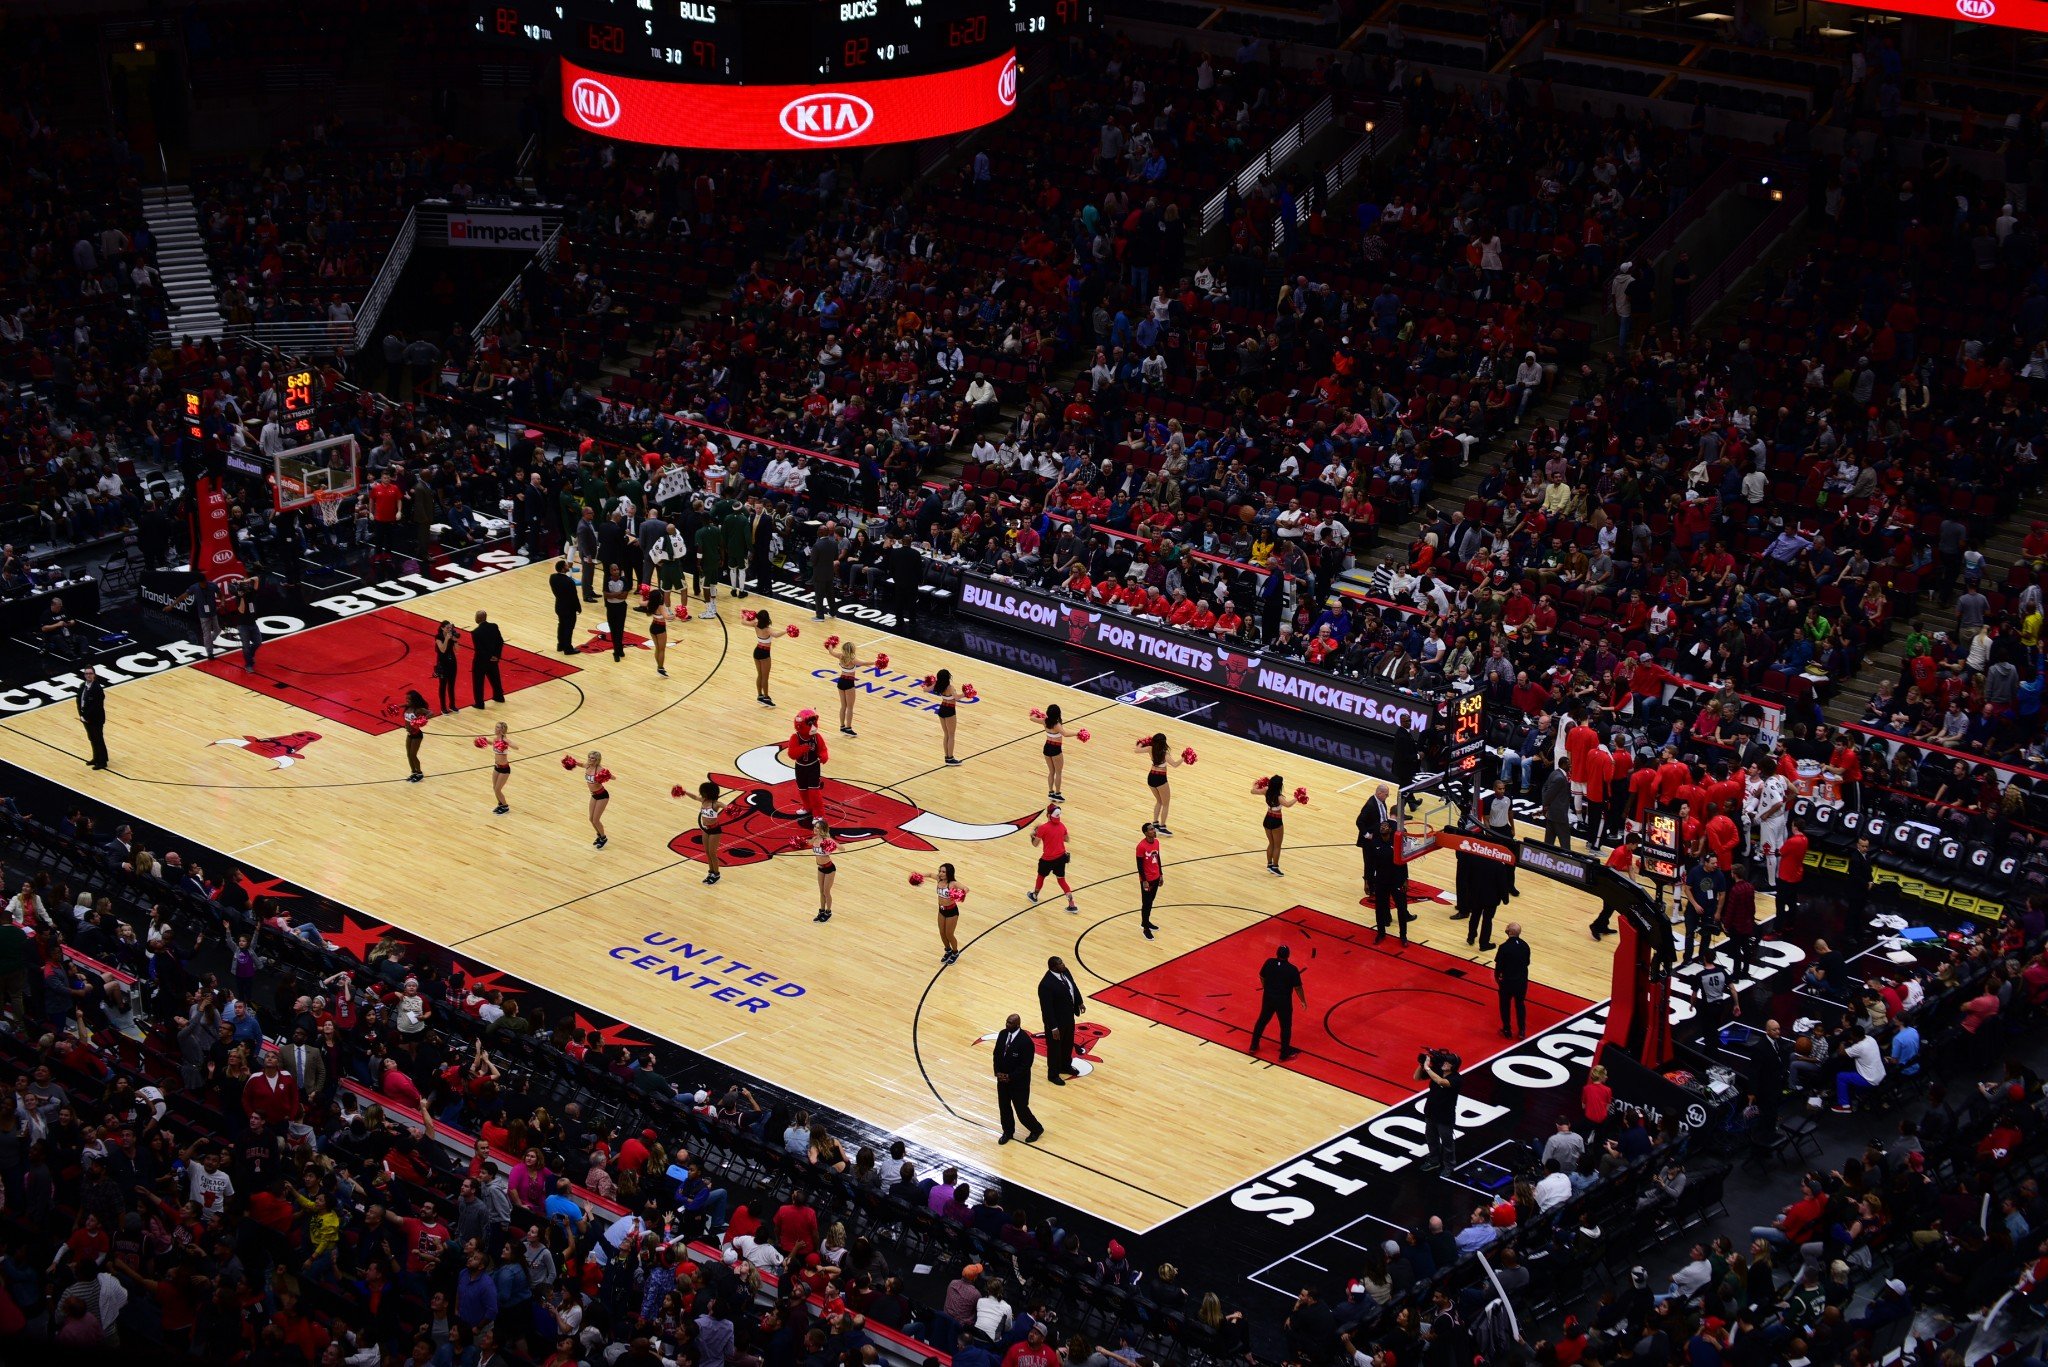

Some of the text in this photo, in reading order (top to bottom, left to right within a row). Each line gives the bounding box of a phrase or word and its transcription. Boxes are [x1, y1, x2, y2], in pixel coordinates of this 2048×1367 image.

[680, 1, 716, 23] BULLS
[840, 1, 878, 21] BUCKS
[1963, 0, 1990, 14] KIA
[496, 7, 517, 36] 82
[1015, 22, 1027, 32] TOL
[588, 25, 625, 54] 6:20
[949, 16, 988, 47] 6:20
[651, 46, 662, 59] TOL
[692, 41, 717, 69] 97
[845, 38, 869, 68] 82
[898, 44, 910, 55] TOL
[577, 87, 612, 120] KIA
[795, 103, 859, 132] KIA
[466, 217, 540, 243] impact
[287, 372, 310, 388] 6:20
[286, 387, 309, 410] 24
[291, 408, 315, 417] TISSOT
[226, 455, 262, 475] Bulls.com
[209, 494, 222, 504] ZTE
[310, 548, 530, 617] BULLS
[963, 583, 1057, 628] BULLS.COM
[1098, 624, 1213, 672] FOR TICKETS
[1258, 668, 1428, 732] NBATICKETS.COM
[1458, 695, 1481, 715] 6:20
[1456, 713, 1478, 743] 24
[1762, 732, 1774, 745] by
[1461, 740, 1484, 755] TISSOT
[1794, 800, 1808, 815] G
[1816, 807, 1830, 822] G
[1655, 816, 1675, 832] 6:20
[1844, 813, 1859, 828] G
[1869, 819, 1884, 834] G
[1895, 826, 1910, 841] G
[1917, 833, 1932, 849] G
[1653, 848, 1676, 860] TISSOT
[1943, 843, 1959, 858] G
[1972, 850, 1988, 865] G
[1521, 847, 1584, 879] Bulls.com
[2000, 858, 2016, 874] G
[643, 931, 806, 998] UNITED
[608, 946, 771, 1014] CENTER
[1708, 976, 1720, 987] 46
[246, 1146, 270, 1159] BULLS
[254, 1159, 261, 1172] 1
[200, 1175, 225, 1187] CHICAGO
